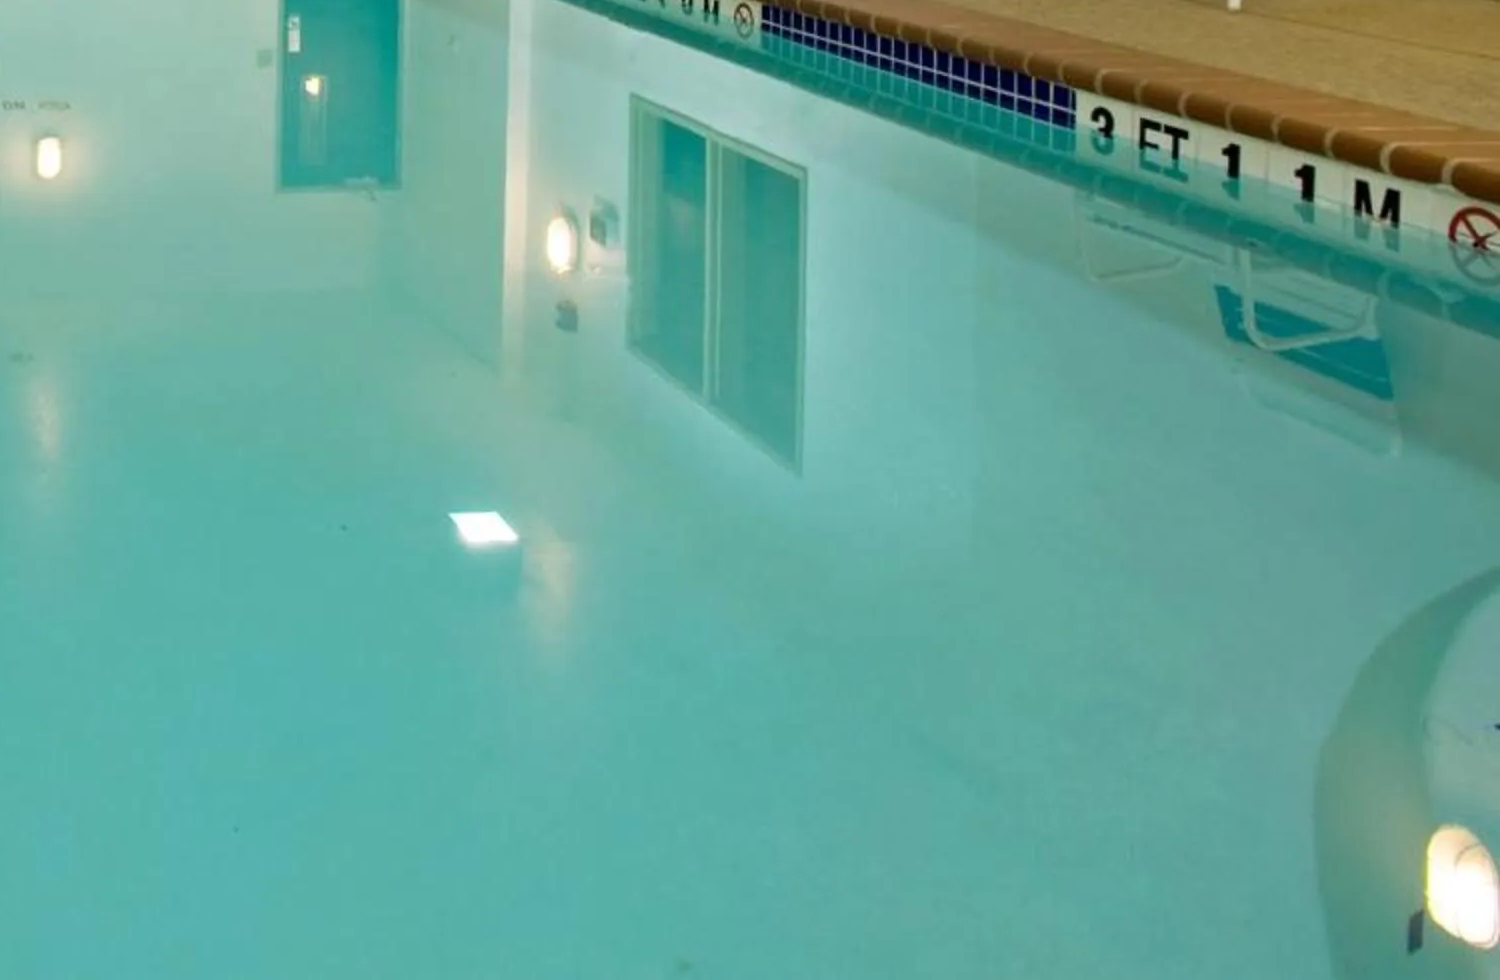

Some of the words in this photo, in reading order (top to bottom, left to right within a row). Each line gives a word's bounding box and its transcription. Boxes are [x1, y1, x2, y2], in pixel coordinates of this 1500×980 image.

[1139, 117, 1189, 161] FT
[1221, 143, 1241, 178] 1
[1295, 164, 1316, 203] 1
[1354, 179, 1401, 228] M
